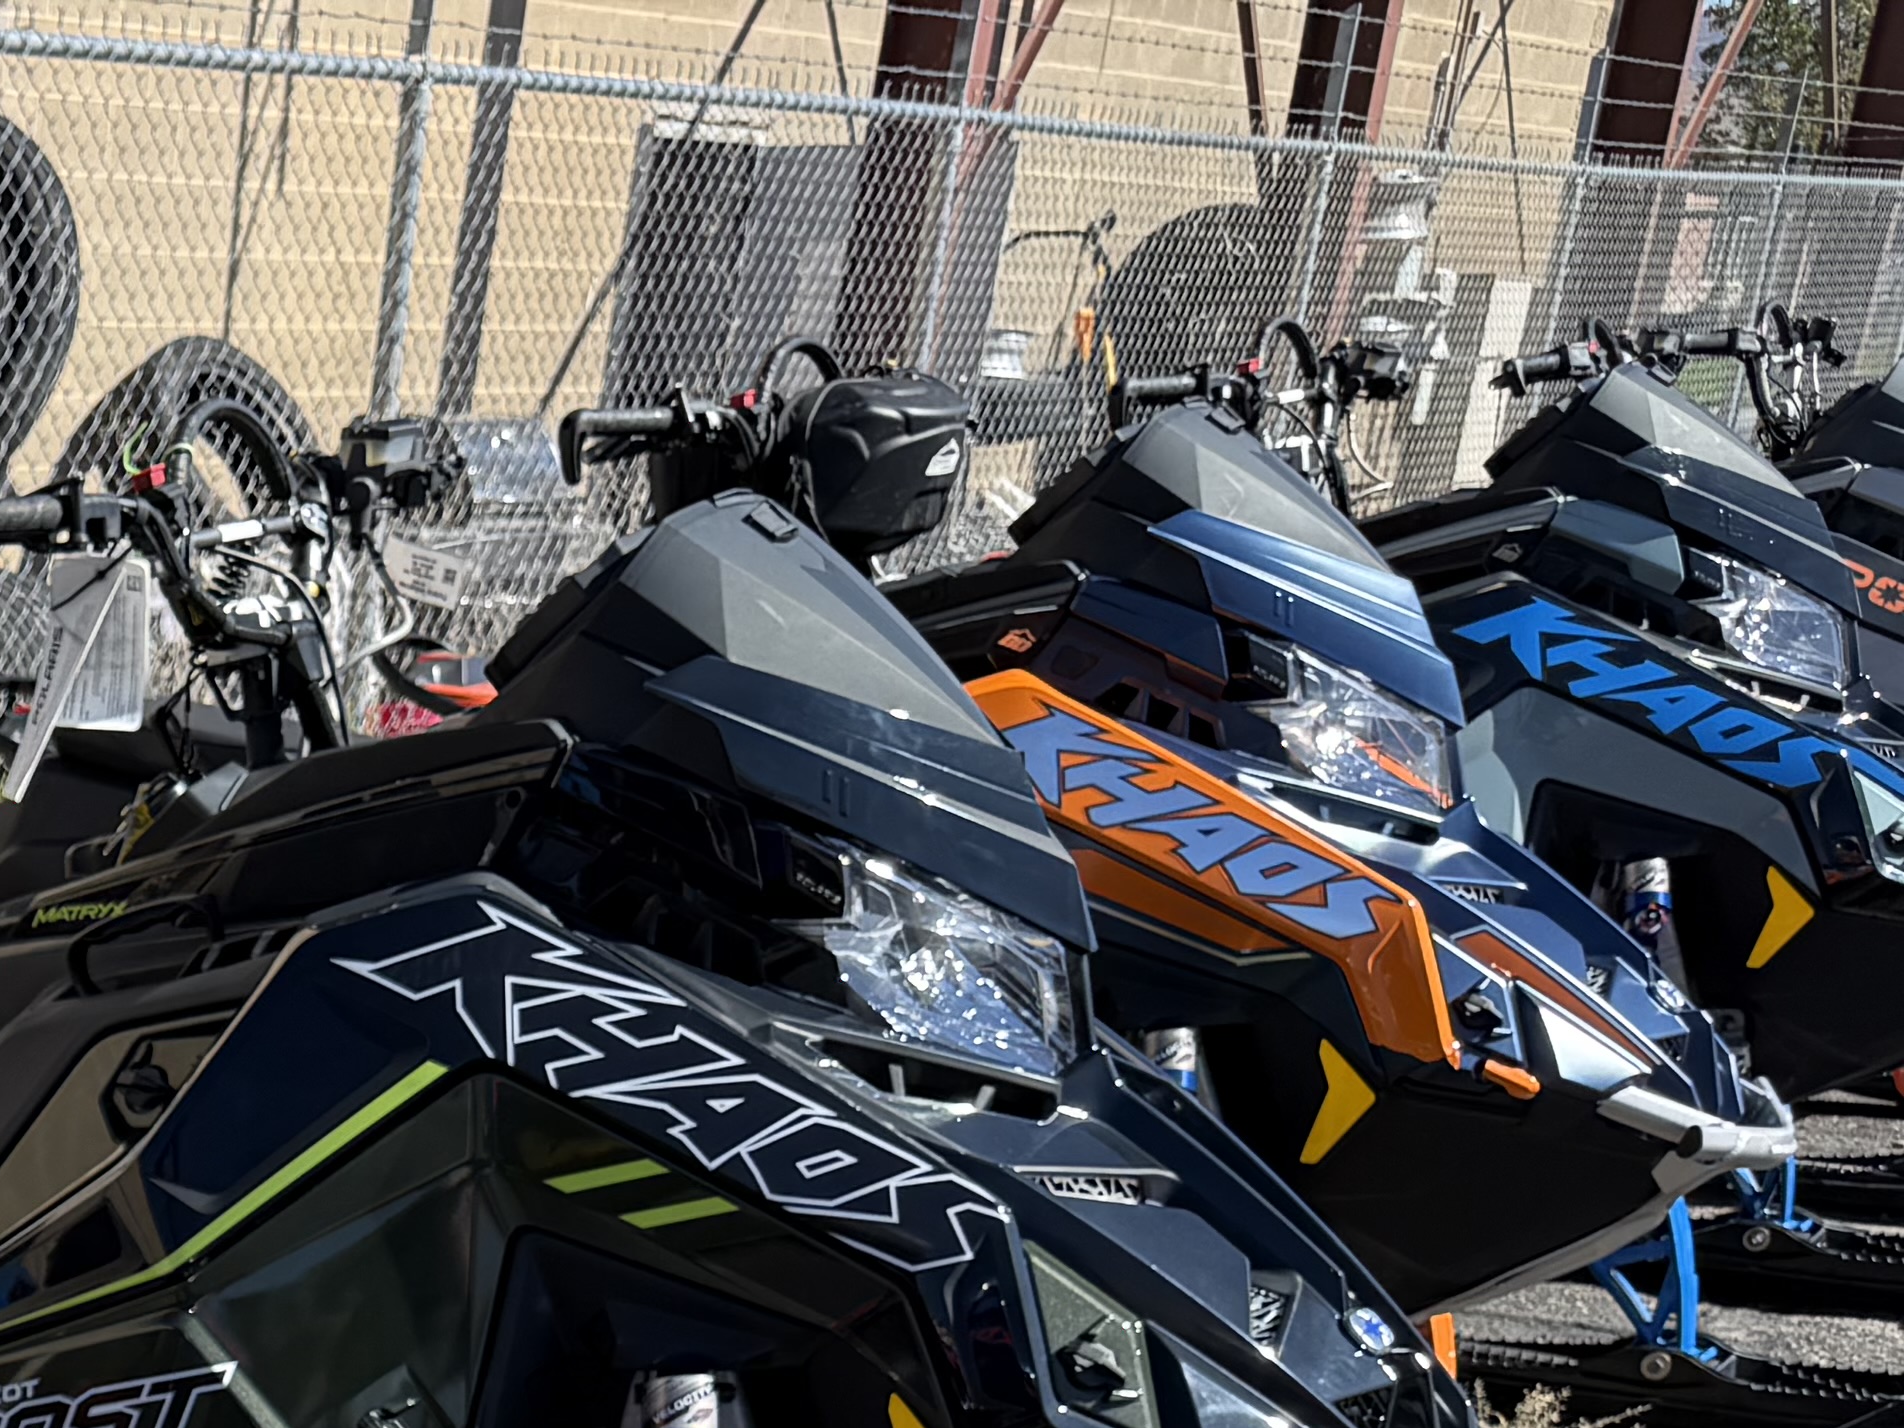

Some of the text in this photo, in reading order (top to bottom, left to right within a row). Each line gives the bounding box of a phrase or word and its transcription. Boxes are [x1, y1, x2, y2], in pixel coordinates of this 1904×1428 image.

[1451, 597, 1844, 788] KHAOS
[1000, 705, 1403, 939] KHAOS
[330, 901, 1011, 1272] KHAOS
